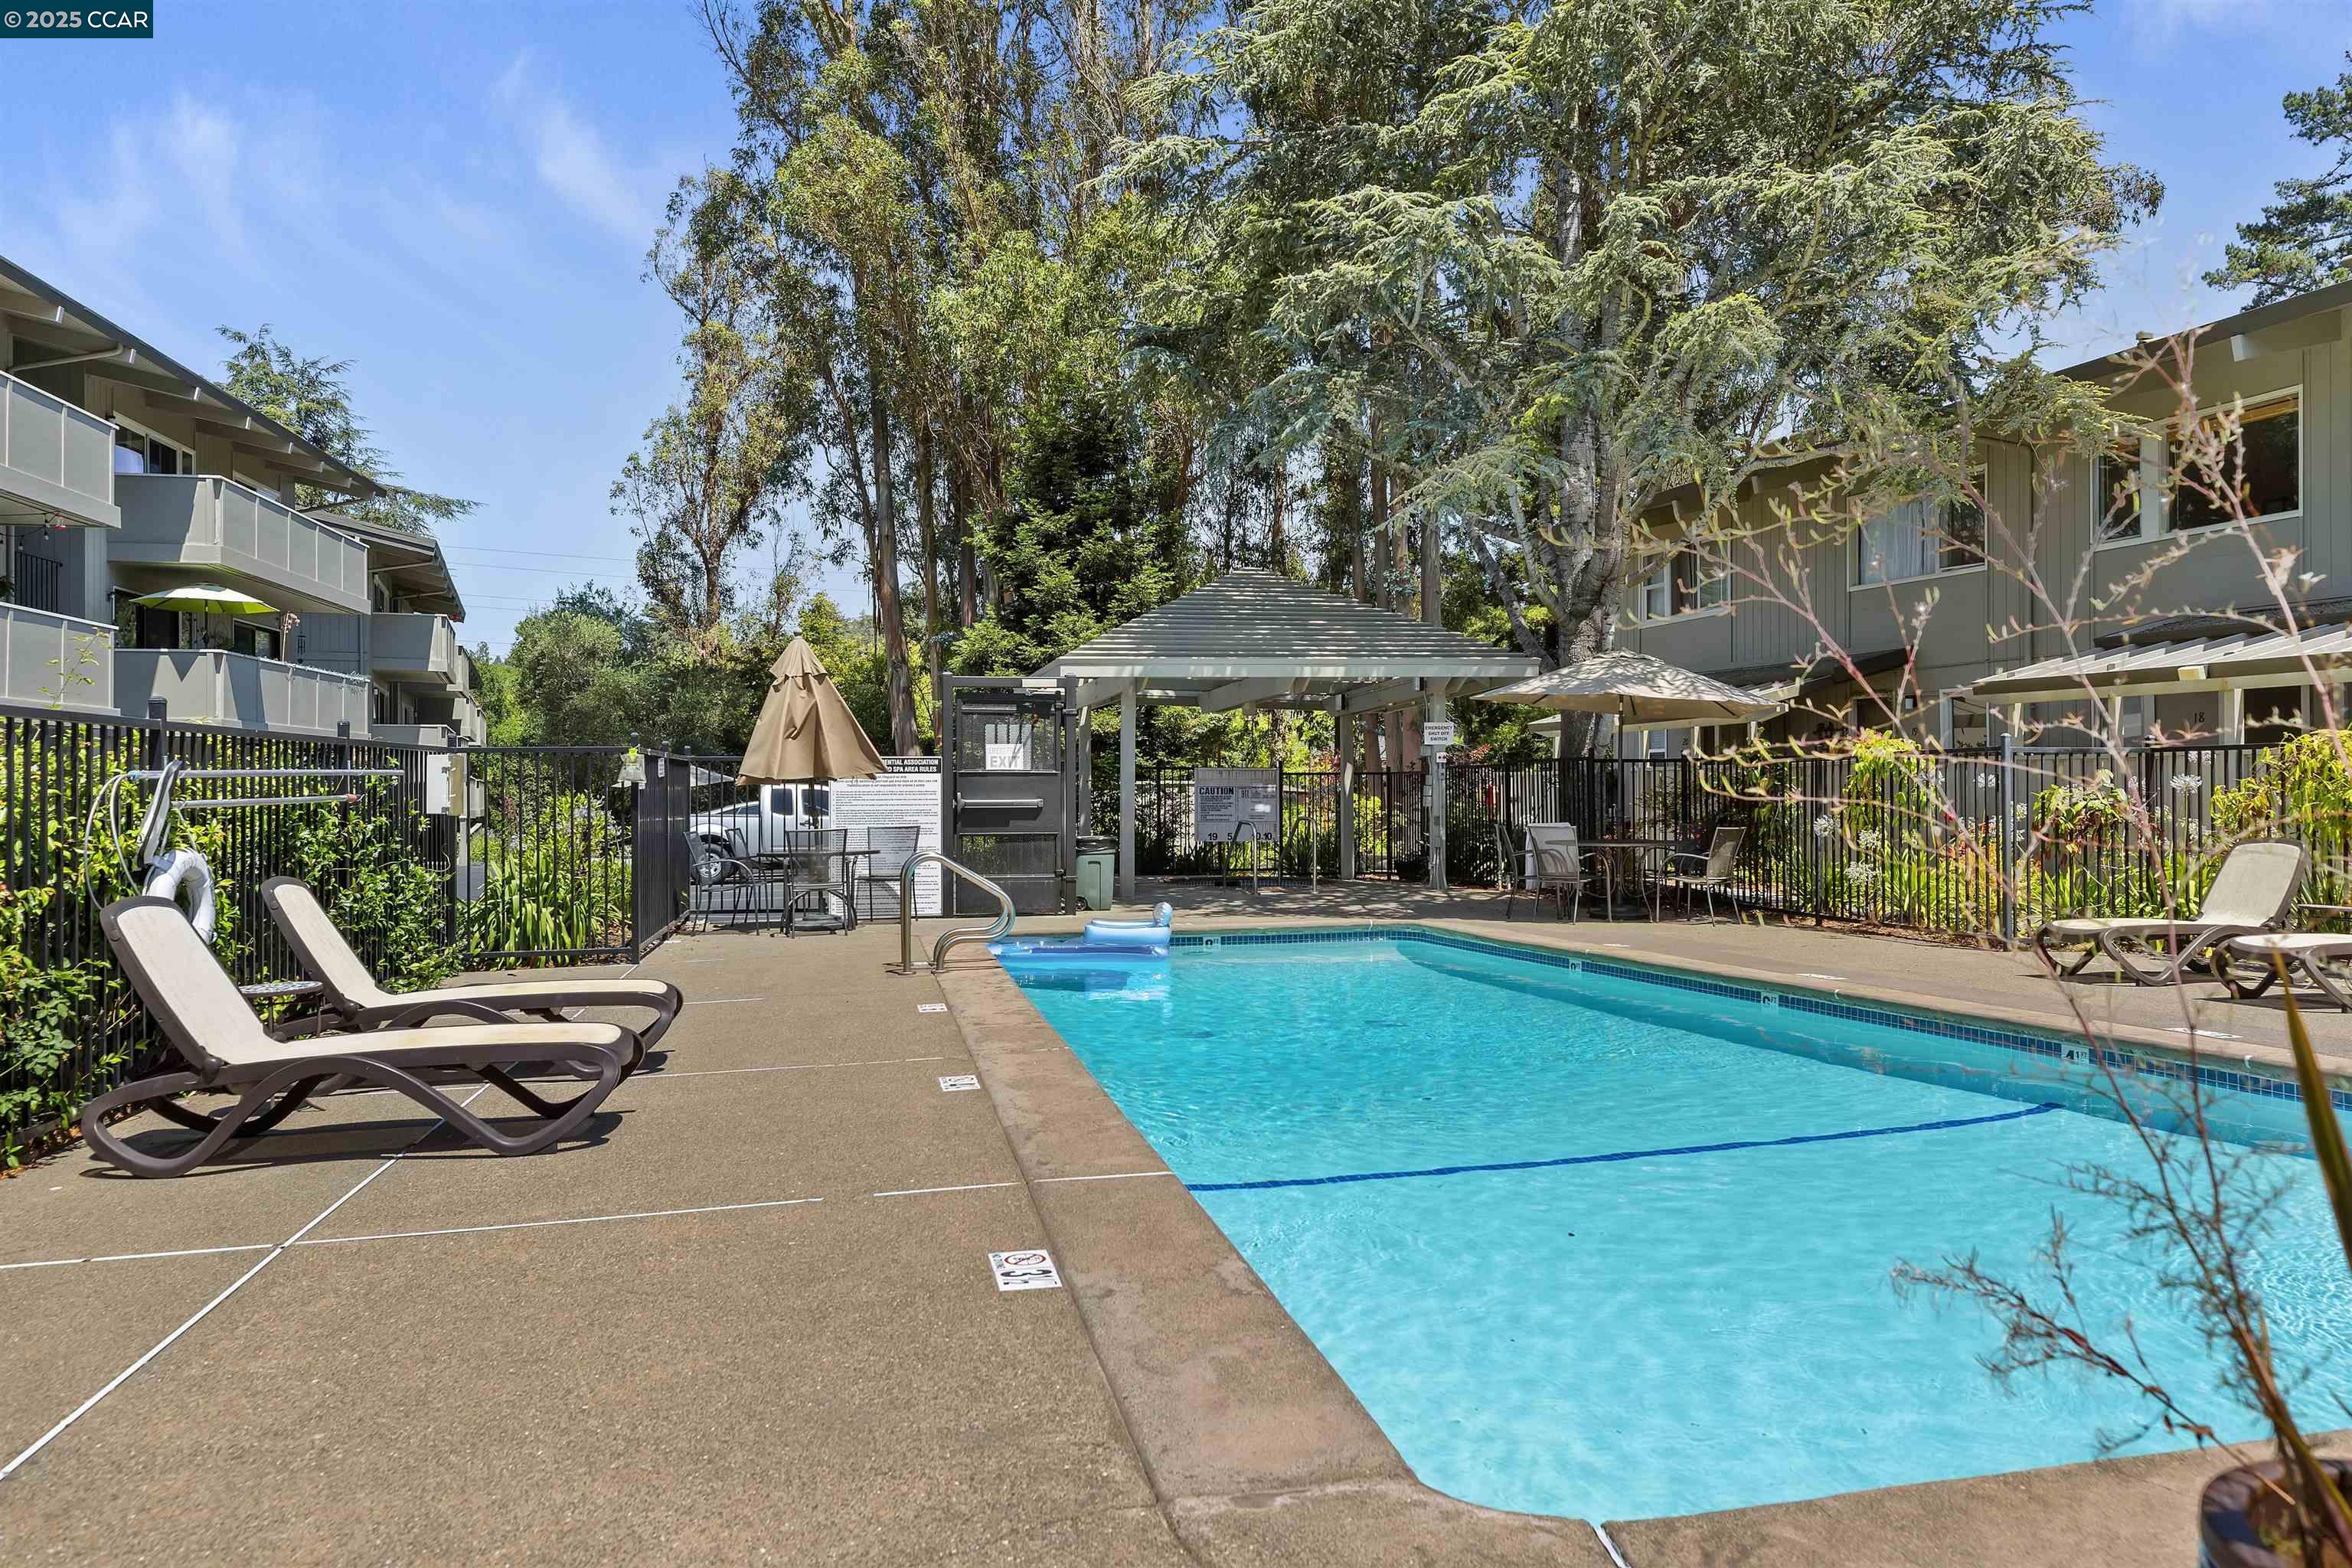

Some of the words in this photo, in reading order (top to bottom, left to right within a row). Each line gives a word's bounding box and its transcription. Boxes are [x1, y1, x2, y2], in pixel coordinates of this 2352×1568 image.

[2194, 711, 2205, 724] 18
[990, 756, 1021, 768] EXIT
[1240, 789, 1250, 799] 911
[1207, 832, 1217, 841] 19
